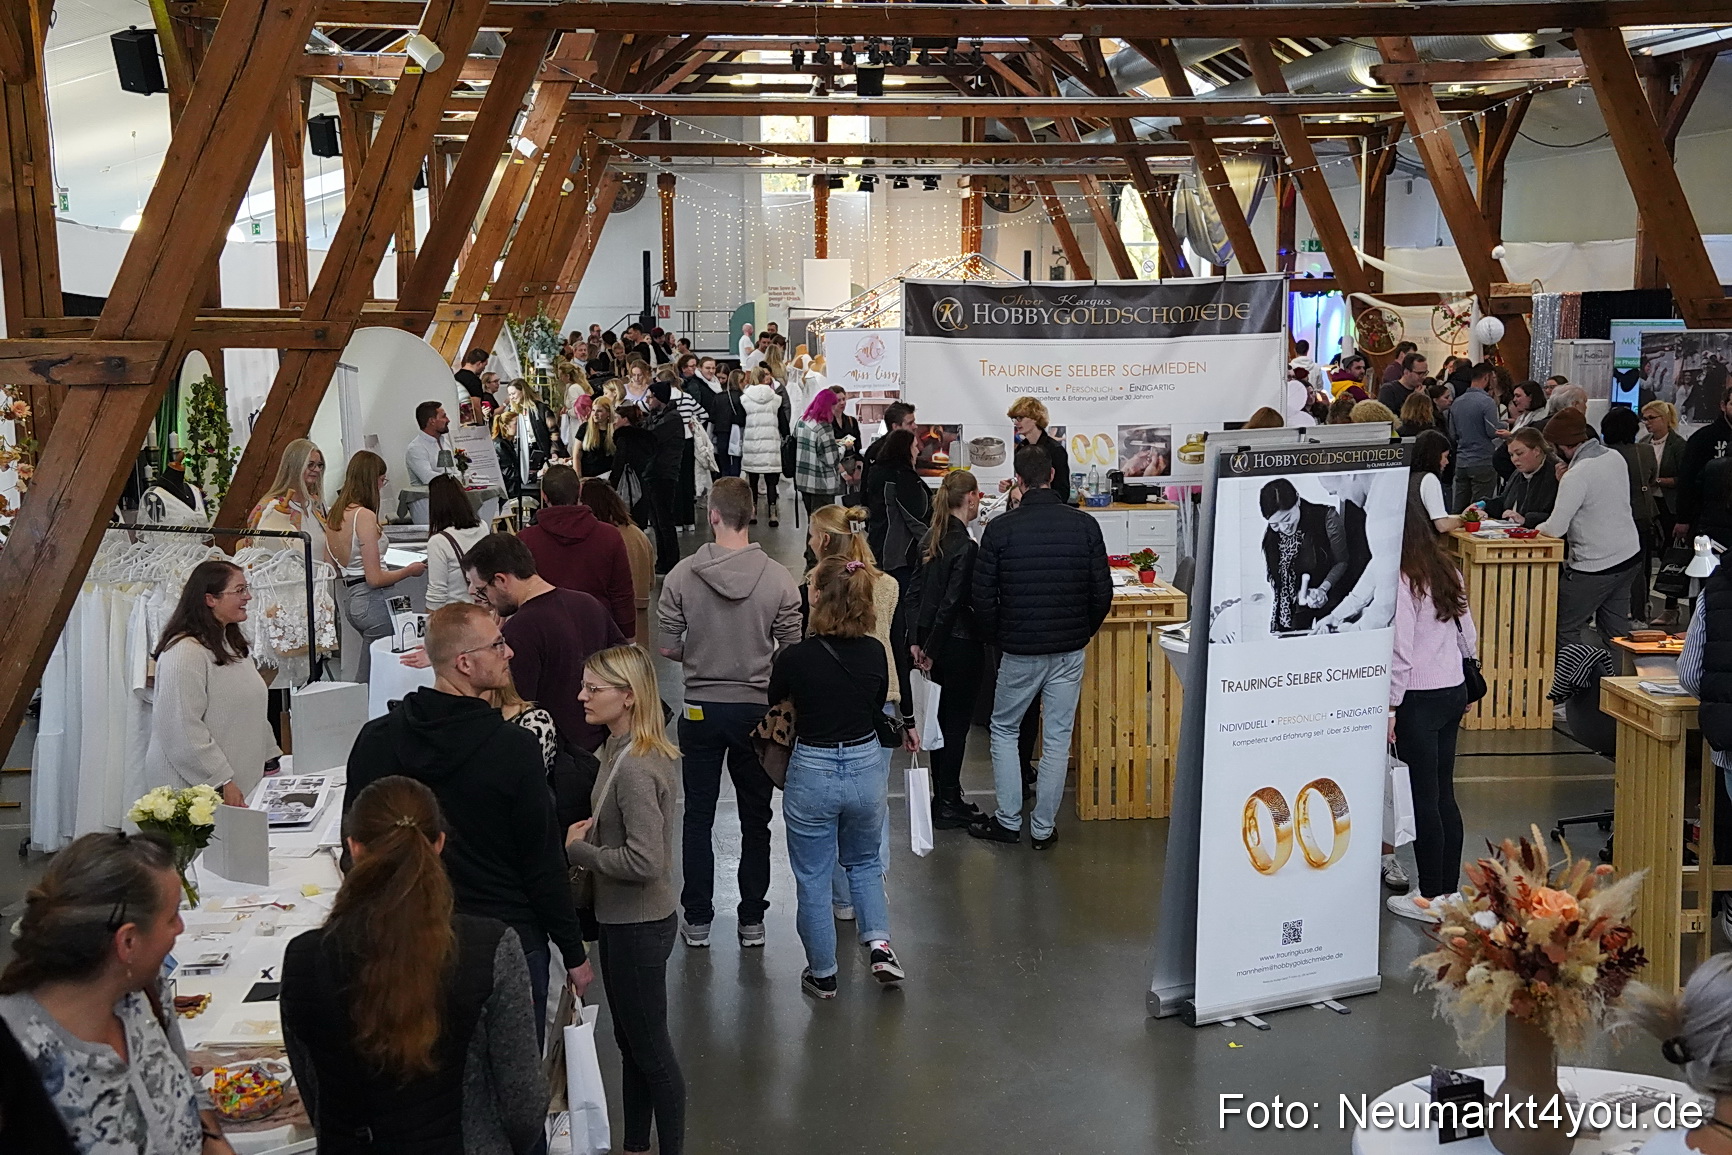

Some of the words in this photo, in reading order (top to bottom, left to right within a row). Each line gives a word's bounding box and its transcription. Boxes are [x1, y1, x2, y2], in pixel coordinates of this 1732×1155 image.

[1000, 295, 1044, 306] Oliver
[1050, 294, 1112, 308] Kargus
[972, 302, 1251, 326] HOBBYGOLDSCHMIEDE
[979, 360, 1062, 377] TRAURINGE
[1068, 363, 1116, 377] SELBER
[1122, 361, 1208, 377] SCHMIEDEN
[1006, 384, 1049, 394] INDIVIDUELL
[1065, 384, 1114, 394] PERSÖNLICH
[1129, 383, 1176, 393] EINZIGARTIG
[1254, 447, 1404, 469] HOBBYGOLDSCHMIEDE
[1221, 675, 1284, 694] TRAURINGE
[1286, 672, 1323, 687] SELBER
[1326, 664, 1387, 683] SCHMIEDEN
[1219, 720, 1268, 733] INDIVIDUELL
[1277, 712, 1328, 726] PERSÖNLICH
[1336, 705, 1384, 720] EINZIGARTIG
[1232, 736, 1268, 748] Kompetenz
[1270, 734, 1282, 743] und
[1282, 730, 1313, 742] Erfahrung
[1314, 729, 1324, 737] seit
[1326, 727, 1342, 736] über
[1352, 724, 1372, 732] Jahren
